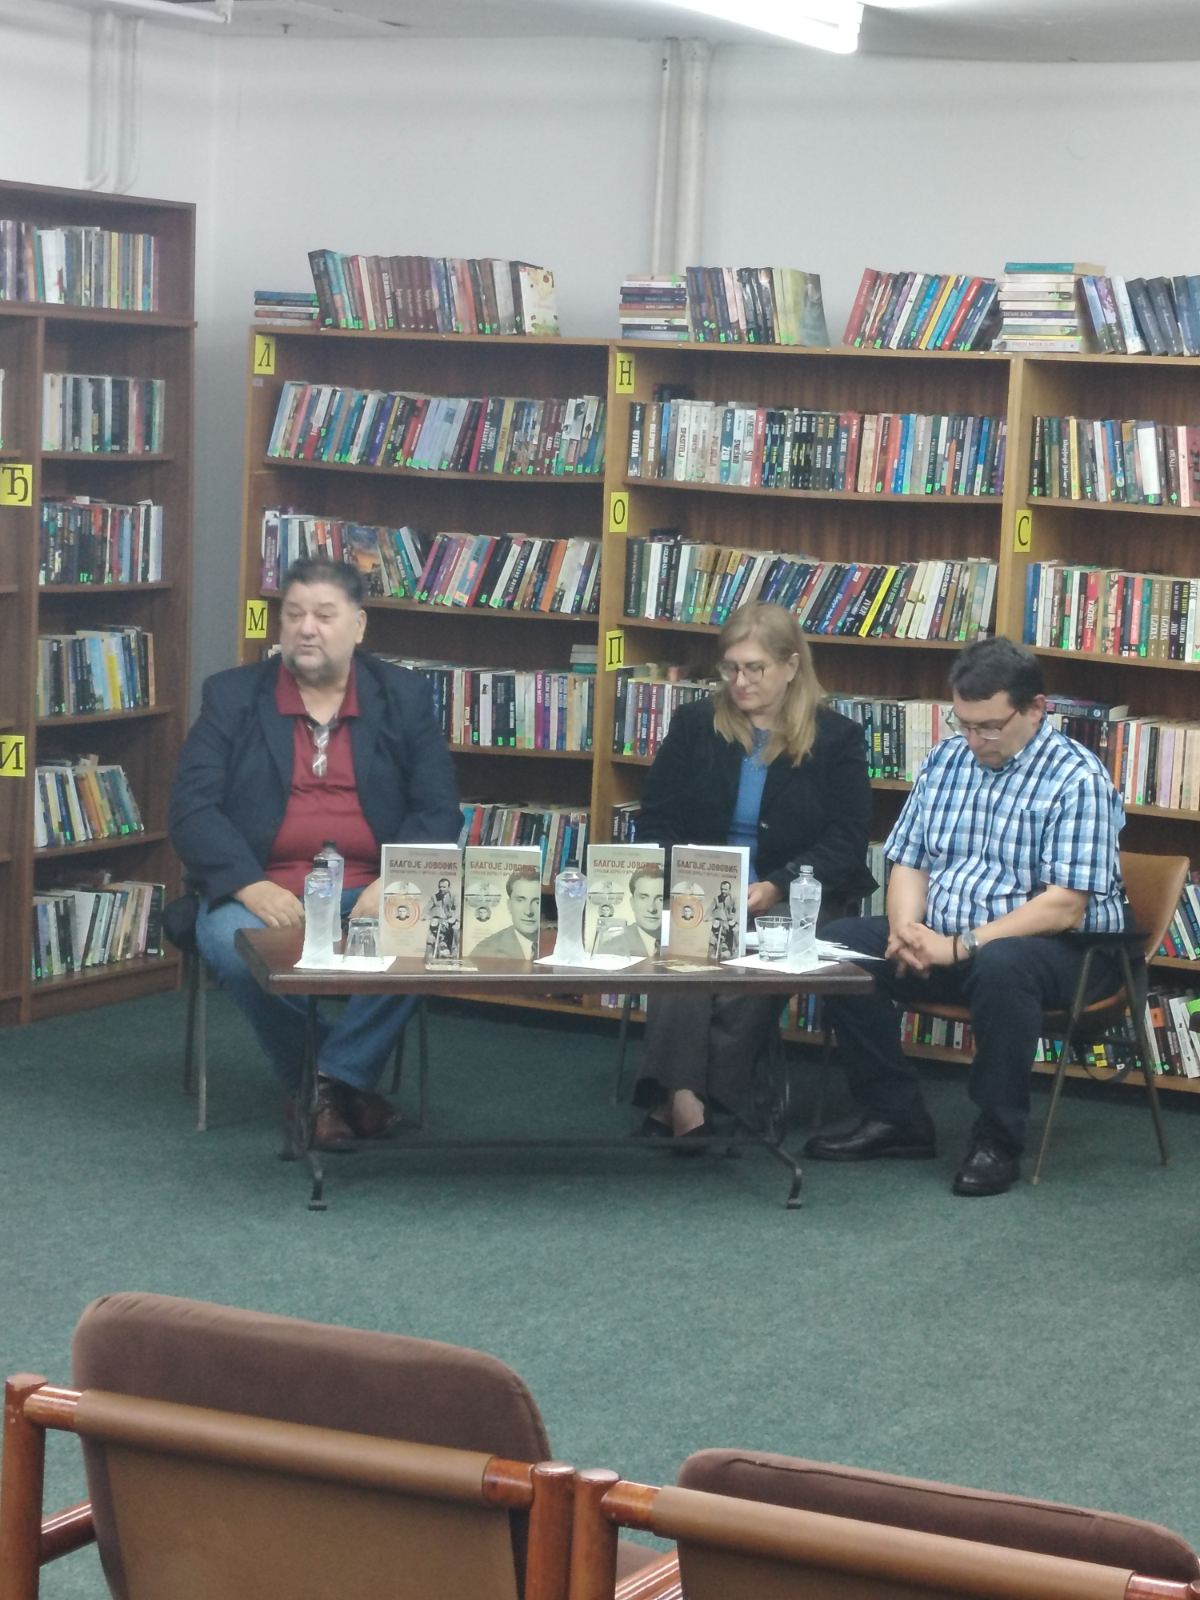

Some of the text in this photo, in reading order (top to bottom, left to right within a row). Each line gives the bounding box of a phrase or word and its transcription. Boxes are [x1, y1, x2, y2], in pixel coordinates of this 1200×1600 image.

[258, 343, 271, 367] Л
[619, 361, 632, 386] Н
[2, 467, 29, 502] Ђ
[248, 607, 266, 631] М
[608, 636, 622, 666] П
[0, 741, 23, 770] И
